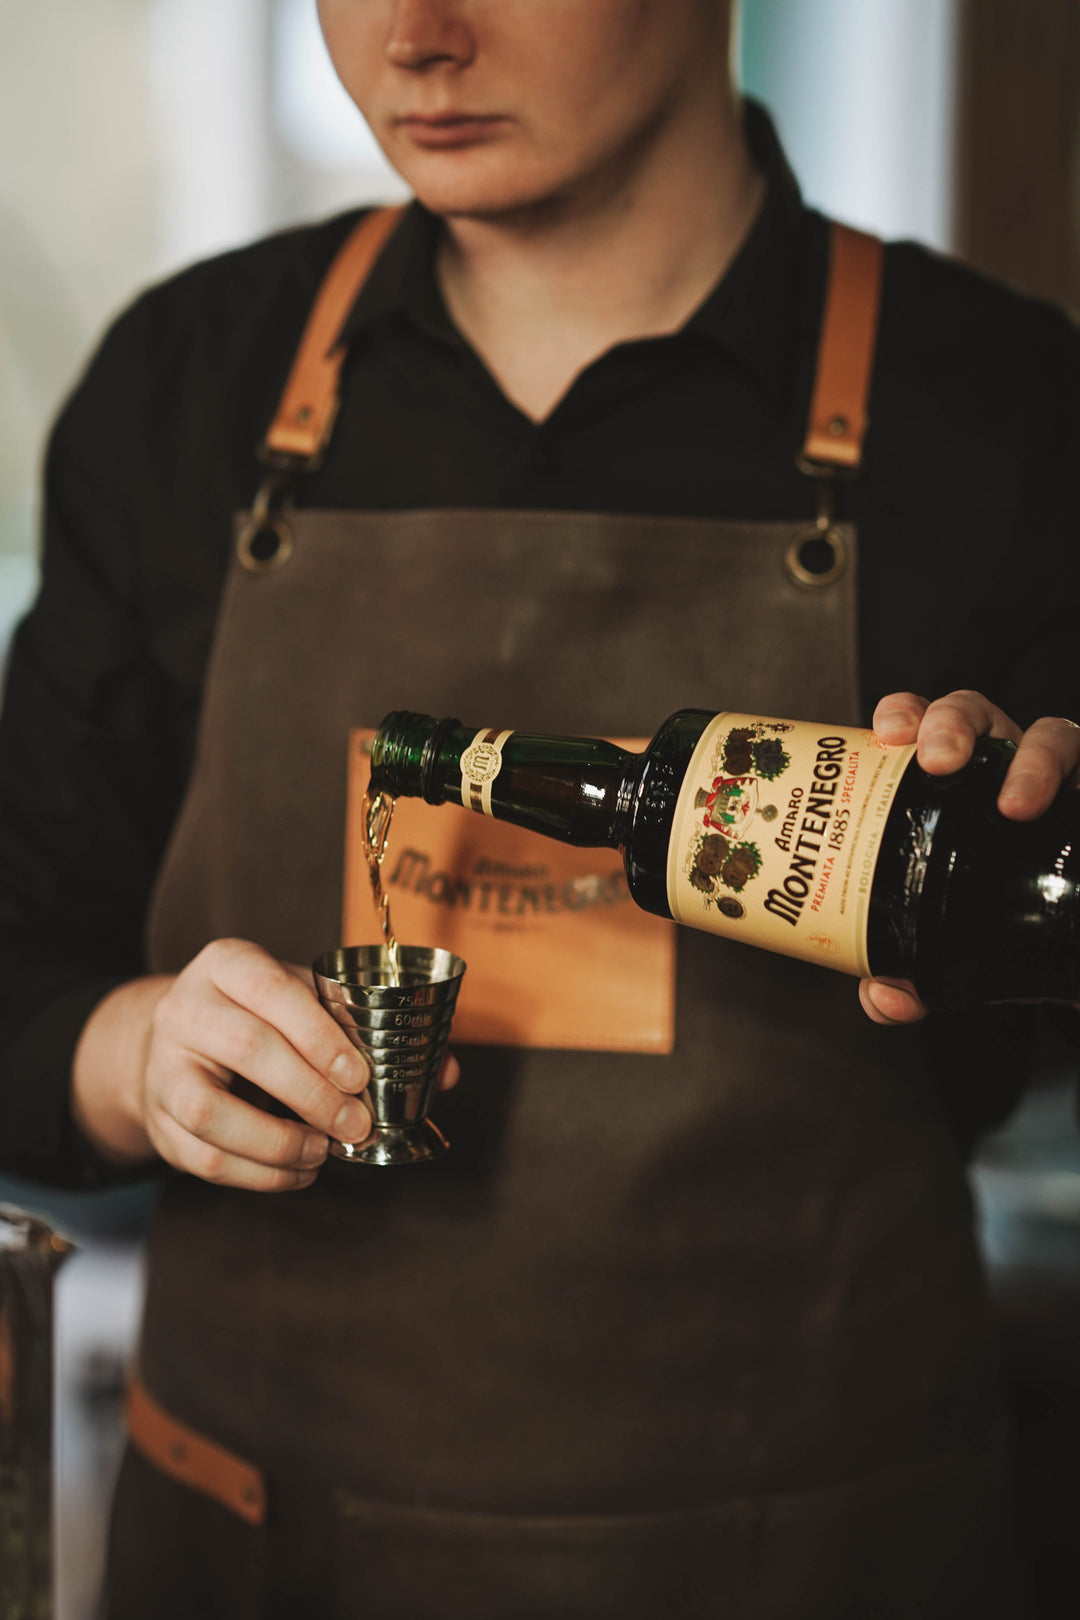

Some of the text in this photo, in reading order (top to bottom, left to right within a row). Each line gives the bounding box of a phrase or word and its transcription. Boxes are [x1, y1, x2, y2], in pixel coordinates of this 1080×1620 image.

[764, 736, 847, 927] MONTENEGRO
[774, 787, 804, 852] AMARO
[810, 857, 836, 912] PREMIATA
[828, 808, 851, 851] 1885
[858, 782, 895, 894] BOLOGNA ITALIA
